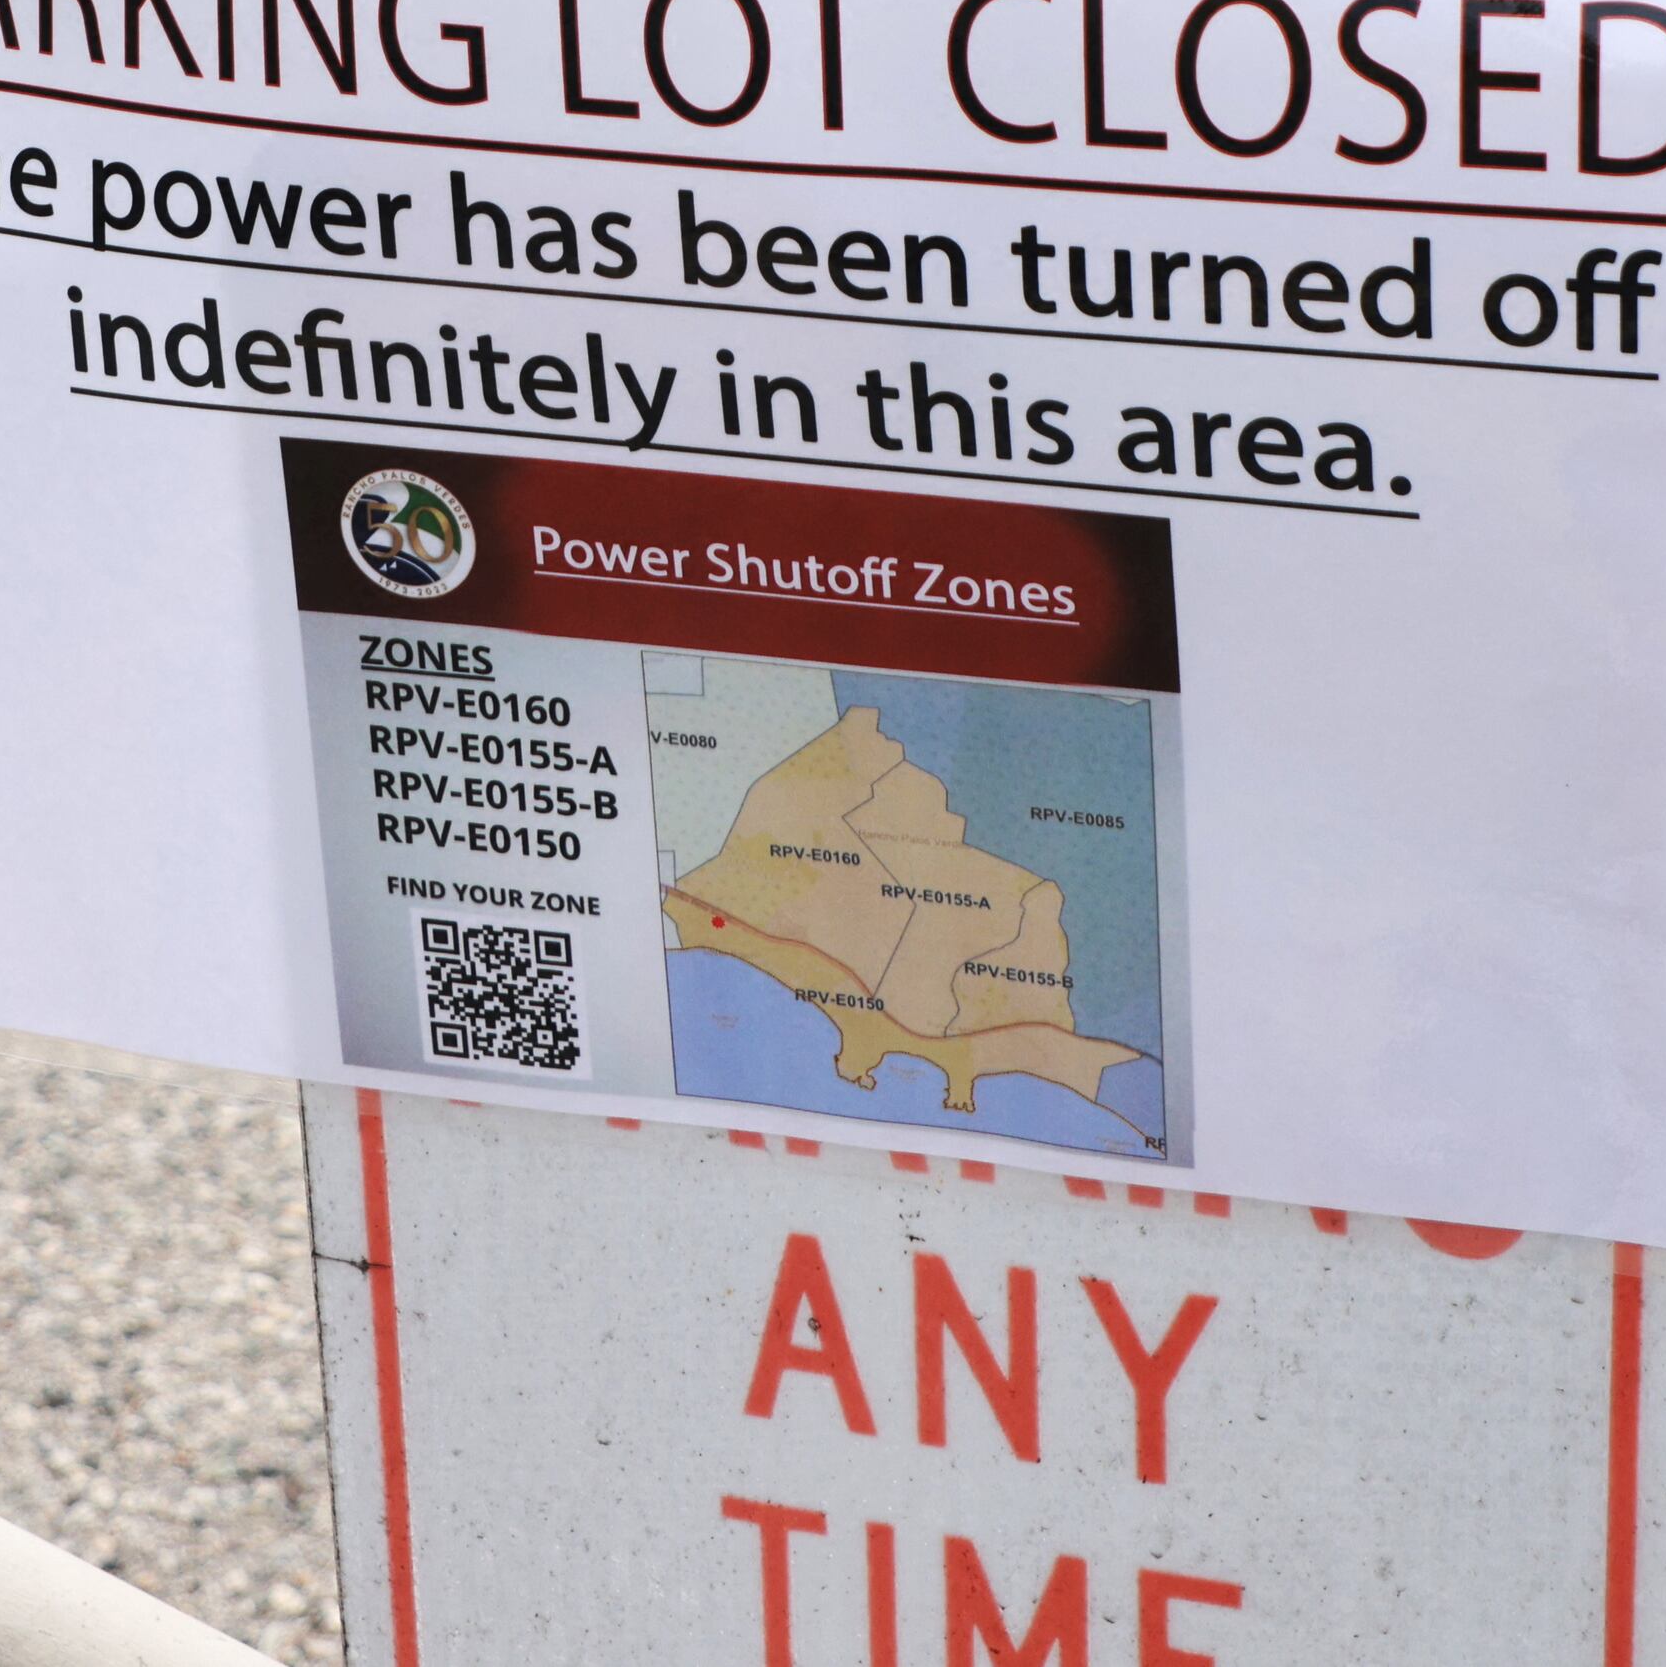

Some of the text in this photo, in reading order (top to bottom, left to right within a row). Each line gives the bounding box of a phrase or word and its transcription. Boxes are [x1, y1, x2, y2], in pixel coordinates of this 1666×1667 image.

[91, 157, 412, 260] power
[449, 170, 638, 280] has
[677, 189, 969, 308] been
[1010, 224, 1433, 340] turned
[1482, 247, 1664, 355] off
[67, 285, 1412, 497] indefinitely in this area.
[343, 470, 471, 530] RANCHO PALOS VERDES
[360, 502, 454, 564] 50
[533, 525, 1076, 616] Power Shutoff Zones
[359, 634, 493, 676] ZONES
[365, 679, 571, 727] RPV-E0160
[369, 724, 618, 776] RPV-E0155-A
[651, 731, 717, 749] V-E0080
[373, 769, 618, 820] RPV-E0155-B
[1030, 806, 1125, 830] RPV-E0085
[377, 812, 581, 861] RPV-E0150
[770, 844, 861, 866] RPV-E0160
[387, 875, 601, 916] FIND YOUR ZONE
[881, 884, 991, 910] RPV-E0155-A
[795, 988, 884, 1011] RPV-E0150
[964, 962, 1074, 989] RPV-E0155-B
[744, 1232, 1220, 1485] ANY
[721, 1495, 1245, 1667] TIME
